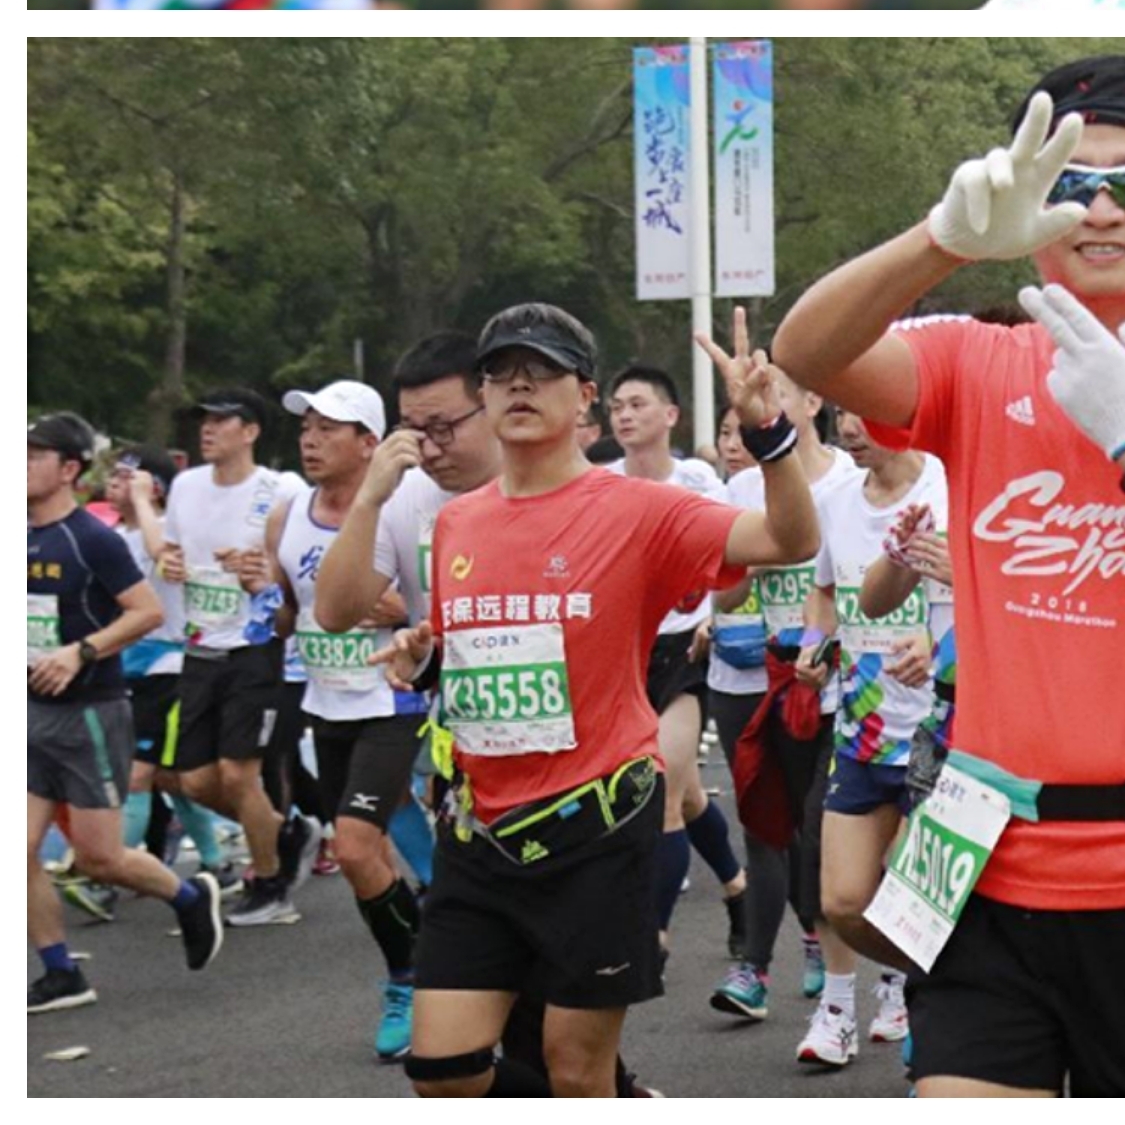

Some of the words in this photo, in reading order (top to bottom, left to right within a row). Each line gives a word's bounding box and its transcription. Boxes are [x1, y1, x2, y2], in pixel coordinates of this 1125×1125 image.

[1030, 593, 1087, 613] 2018
[1063, 608, 1117, 628] Marathon
[301, 638, 375, 667] K33820
[443, 669, 565, 719] K35558
